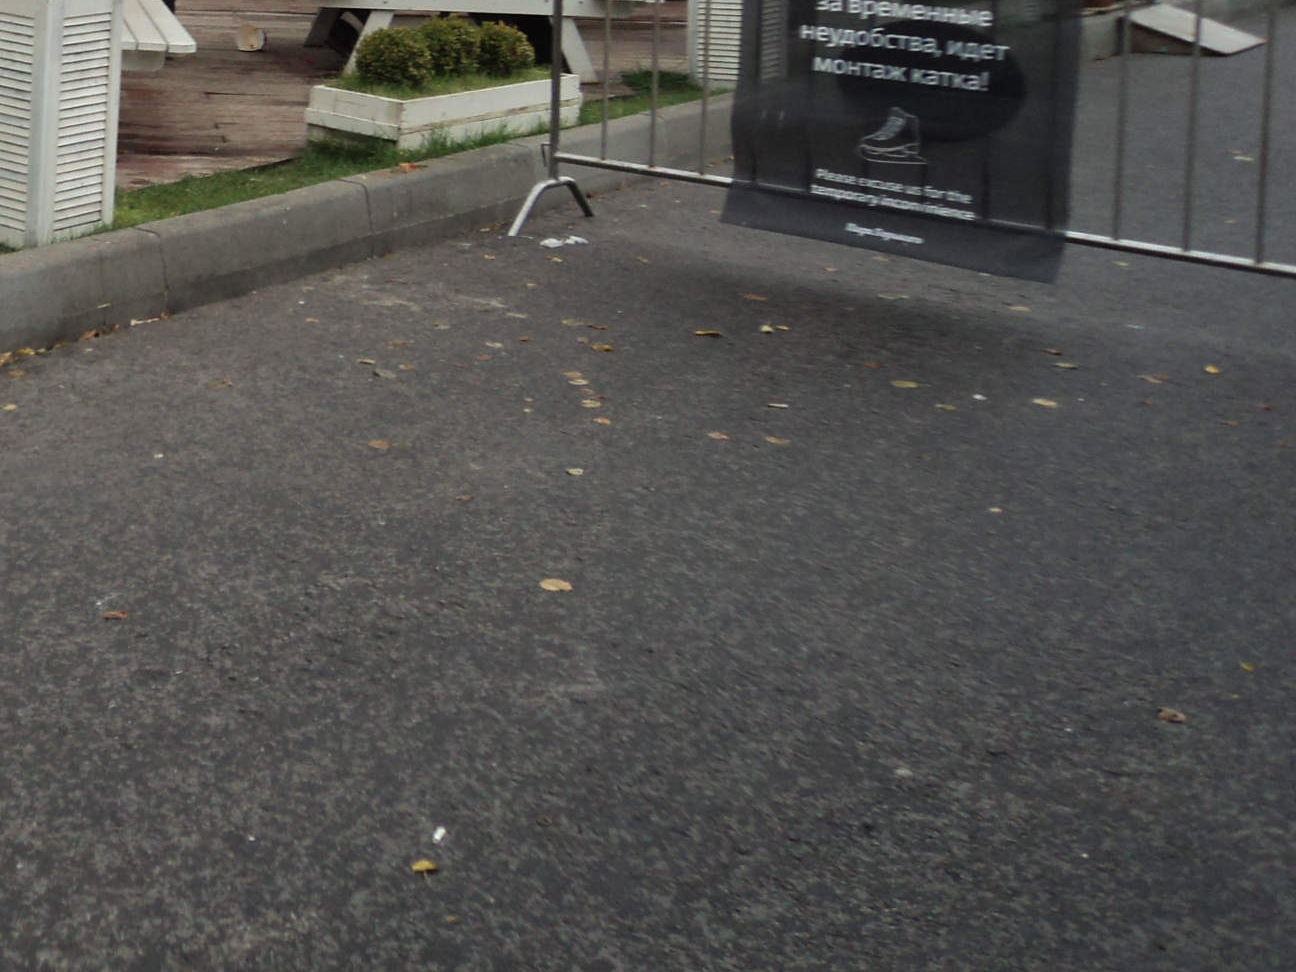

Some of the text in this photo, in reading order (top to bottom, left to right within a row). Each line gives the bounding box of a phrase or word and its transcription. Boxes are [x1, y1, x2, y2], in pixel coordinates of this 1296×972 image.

[799, 25, 1010, 62] неудобства, идет
[813, 56, 989, 91] монтаж катка!
[810, 184, 879, 207] temporary
[815, 168, 973, 204] Please excuse us for the
